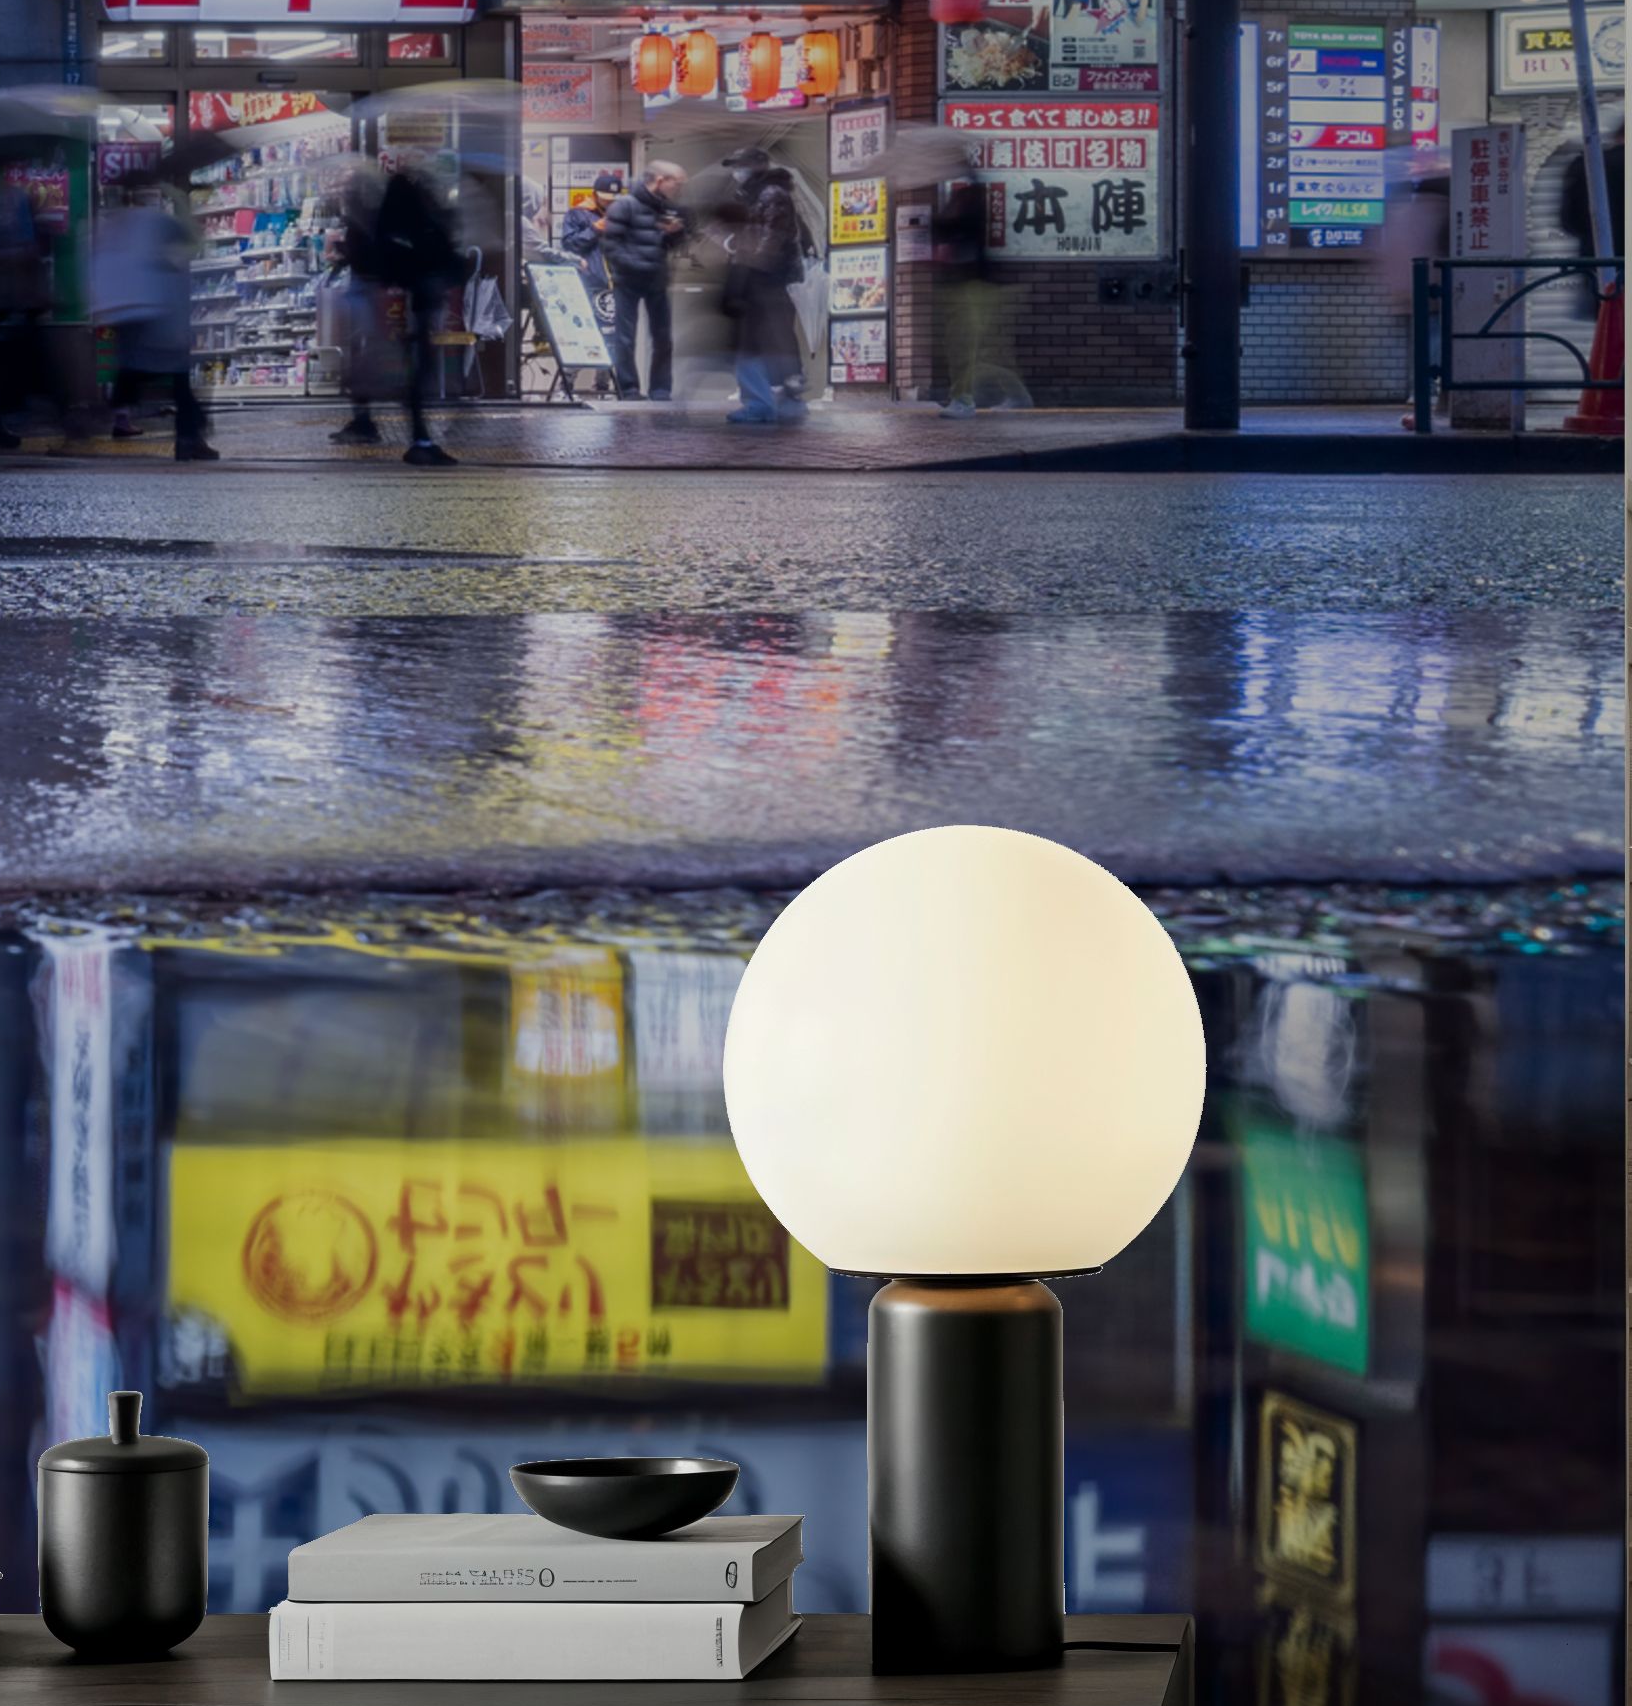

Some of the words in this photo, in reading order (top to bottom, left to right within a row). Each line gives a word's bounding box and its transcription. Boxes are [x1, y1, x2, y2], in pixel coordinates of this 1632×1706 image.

[1524, 29, 1575, 51] 買取
[1392, 28, 1406, 80] TOYA
[1052, 72, 1078, 89] B2F
[1086, 70, 1152, 83] ファイトフィット
[951, 108, 1004, 127] 作って
[1008, 108, 1062, 127] 食べて
[1064, 107, 1152, 127] 楽しめる!!
[1392, 85, 1406, 131] BLDG
[1335, 130, 1374, 145] アコム
[1470, 138, 1491, 251] 駐停車禁止
[1013, 178, 1147, 236] 本陣
